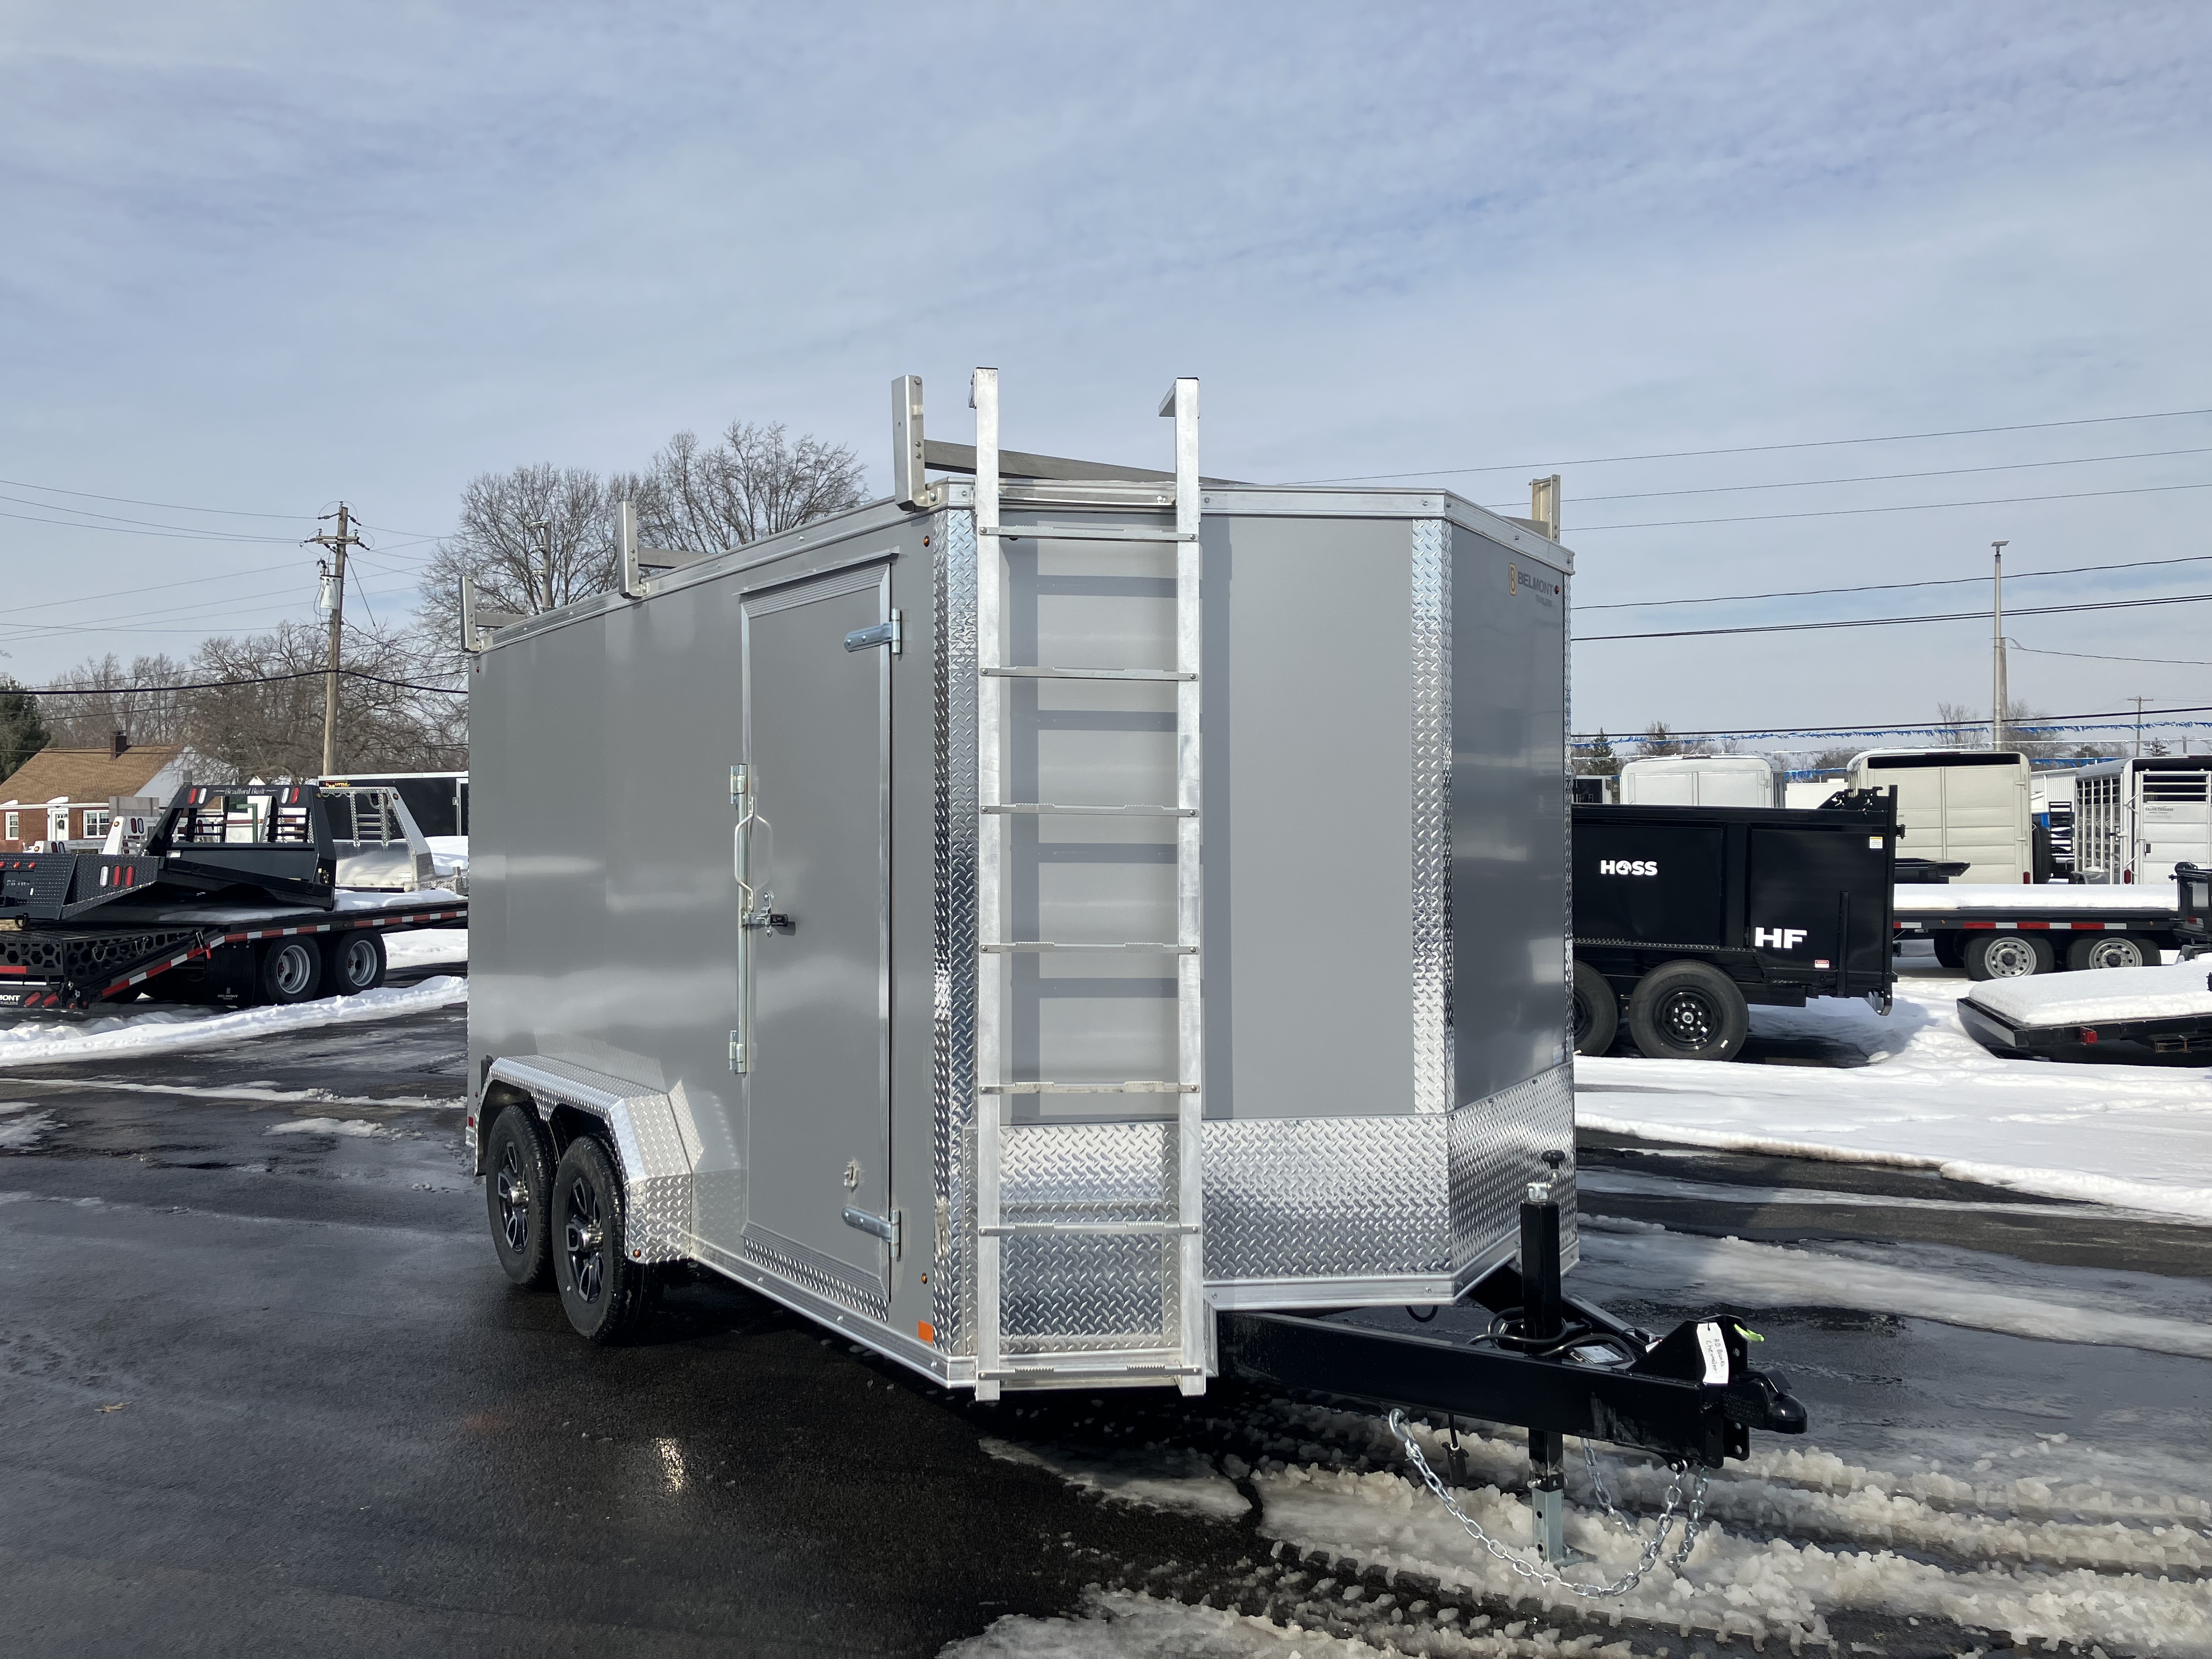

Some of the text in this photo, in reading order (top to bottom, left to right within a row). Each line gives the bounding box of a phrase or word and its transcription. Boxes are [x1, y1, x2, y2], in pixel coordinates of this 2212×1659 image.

[1517, 571, 1553, 596] BELMONT
[1600, 860, 1658, 876] HOSS
[1755, 927, 1807, 949] HF
